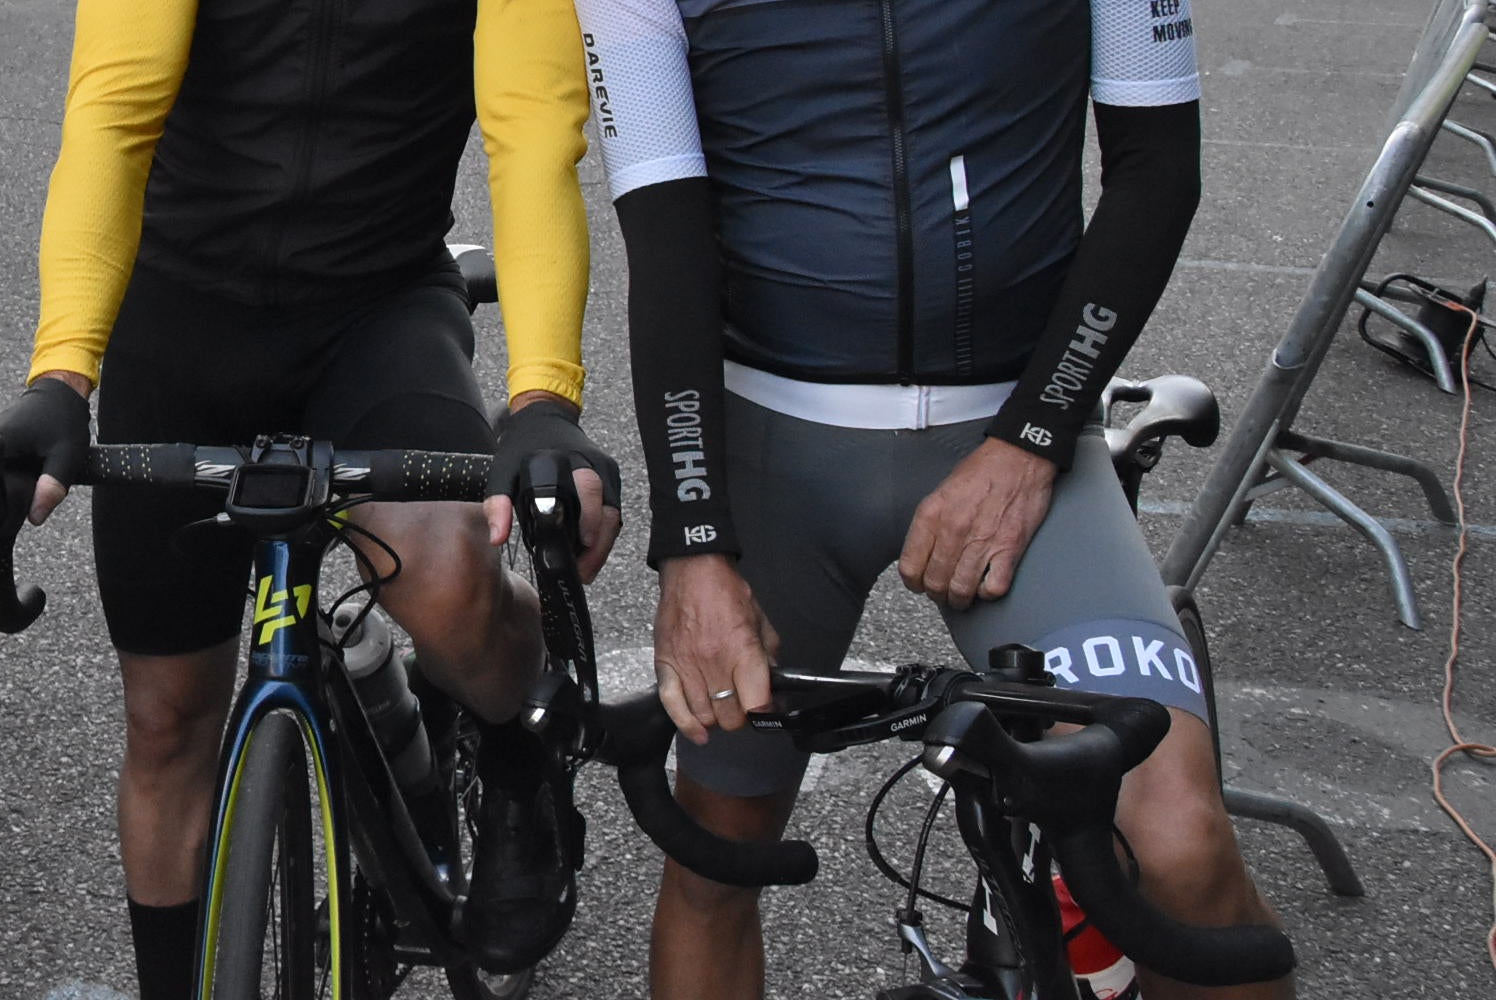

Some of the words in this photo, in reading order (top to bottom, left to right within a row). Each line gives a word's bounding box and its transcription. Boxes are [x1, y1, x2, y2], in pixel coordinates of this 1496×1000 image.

[583, 33, 617, 138] DAREVIE
[752, 720, 782, 728] GARMIN
[891, 713, 927, 732] GARMIN
